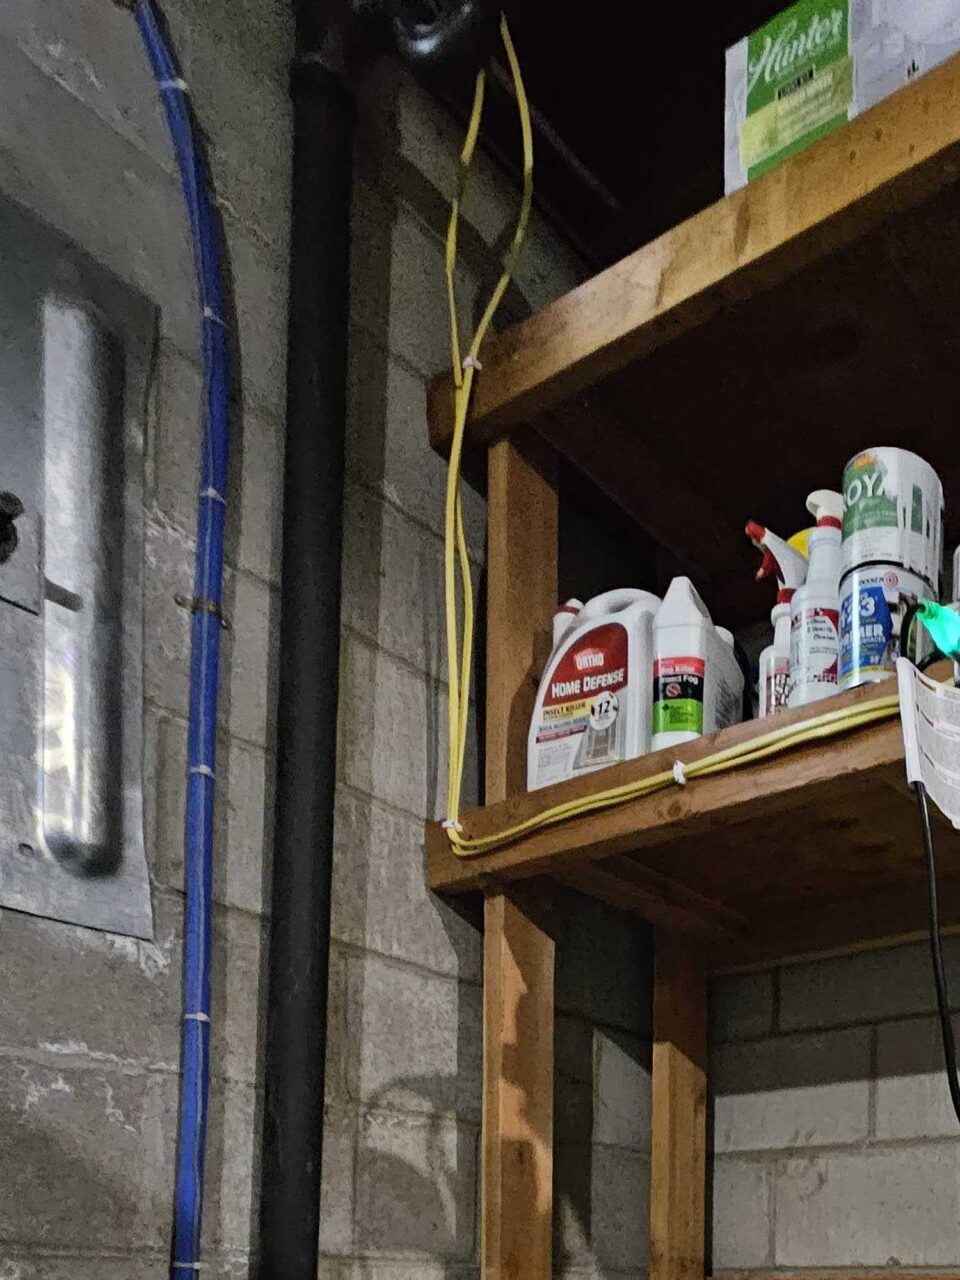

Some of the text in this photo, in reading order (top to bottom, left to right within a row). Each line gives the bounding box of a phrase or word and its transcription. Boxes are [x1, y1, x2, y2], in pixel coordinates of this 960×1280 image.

[748, 8, 844, 96] Hunter
[551, 668, 625, 698] HOME DEFENSE
[598, 700, 610, 715] 12
